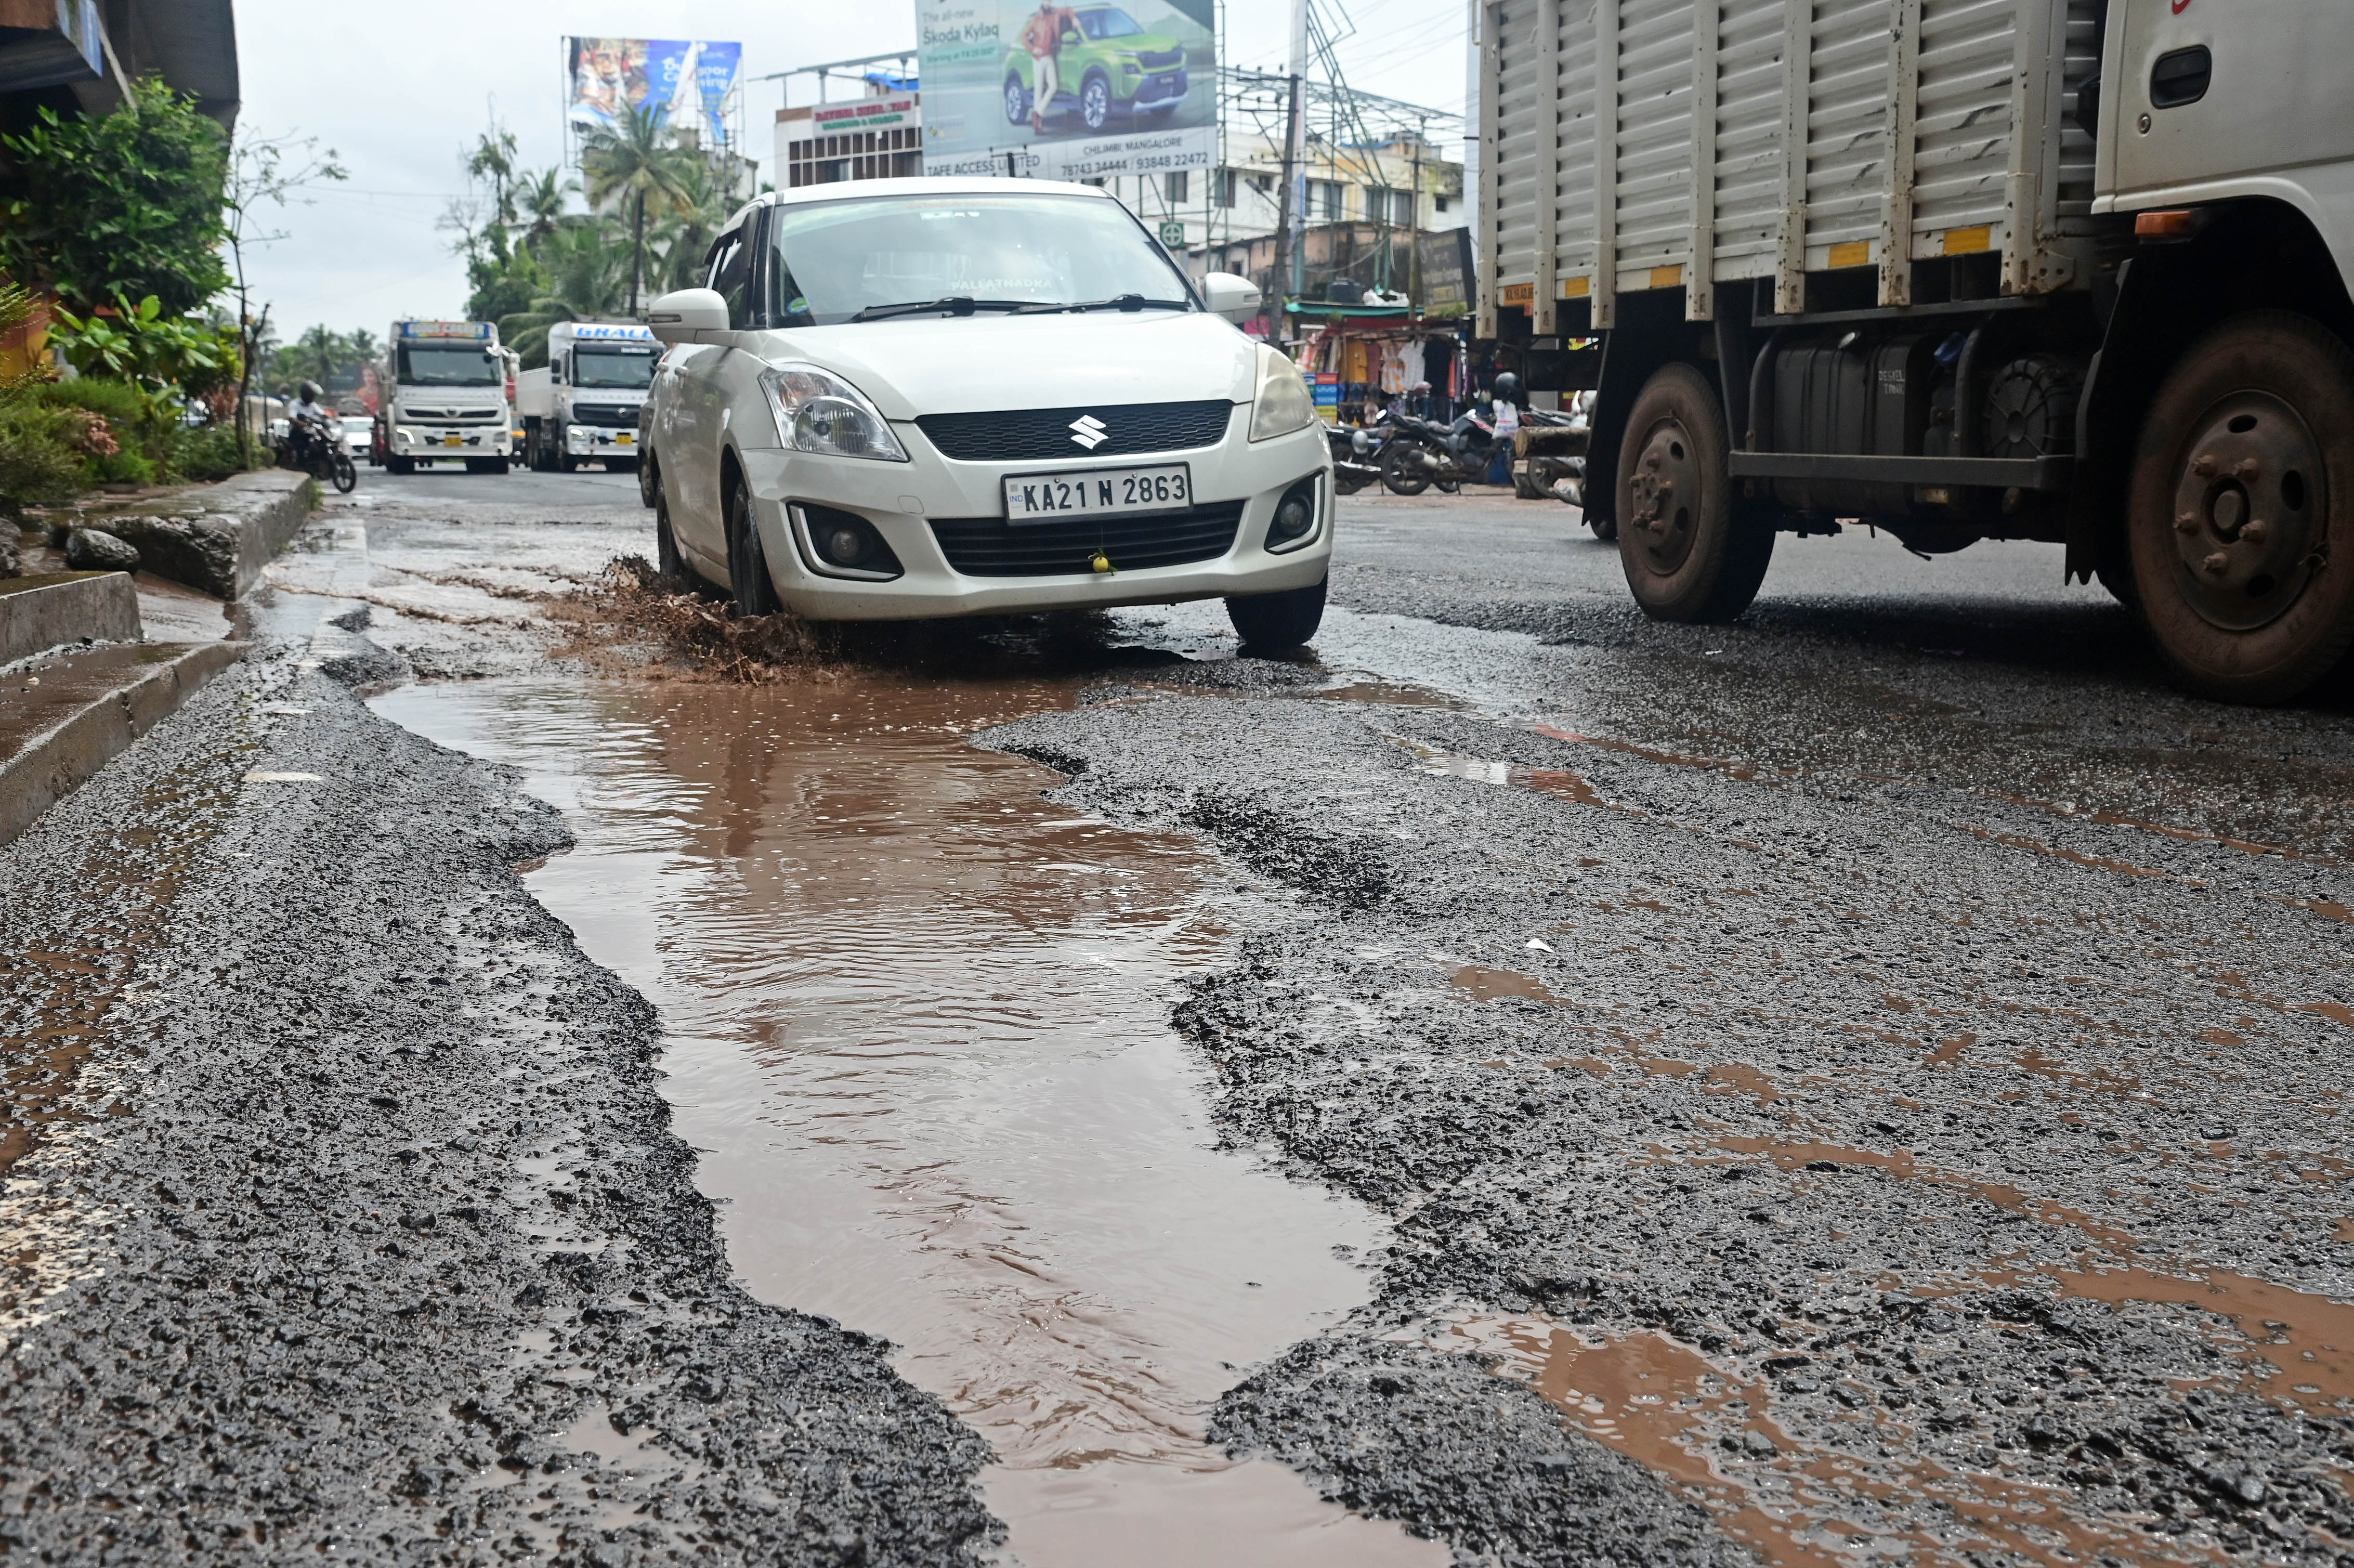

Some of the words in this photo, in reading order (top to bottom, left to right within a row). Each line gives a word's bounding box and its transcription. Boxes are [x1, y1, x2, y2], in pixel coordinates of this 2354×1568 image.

[923, 12, 939, 22] The
[942, 9, 975, 21] all-new
[923, 27, 961, 45] Škoda
[964, 22, 999, 42] Kylaq
[1126, 137, 1182, 150] MANGALORE
[927, 165, 951, 176] TAFE
[955, 160, 995, 174] ACCESS
[998, 155, 1040, 171] LIITED
[1061, 163, 1091, 176] 78743
[1095, 160, 1128, 173] 34444
[1136, 155, 1171, 169] 93848
[1174, 152, 1209, 165] 22472
[1010, 494, 1023, 503] IND
[1024, 481, 1086, 512] KA21
[1098, 479, 1113, 506] N
[1122, 474, 1185, 505] 2863
